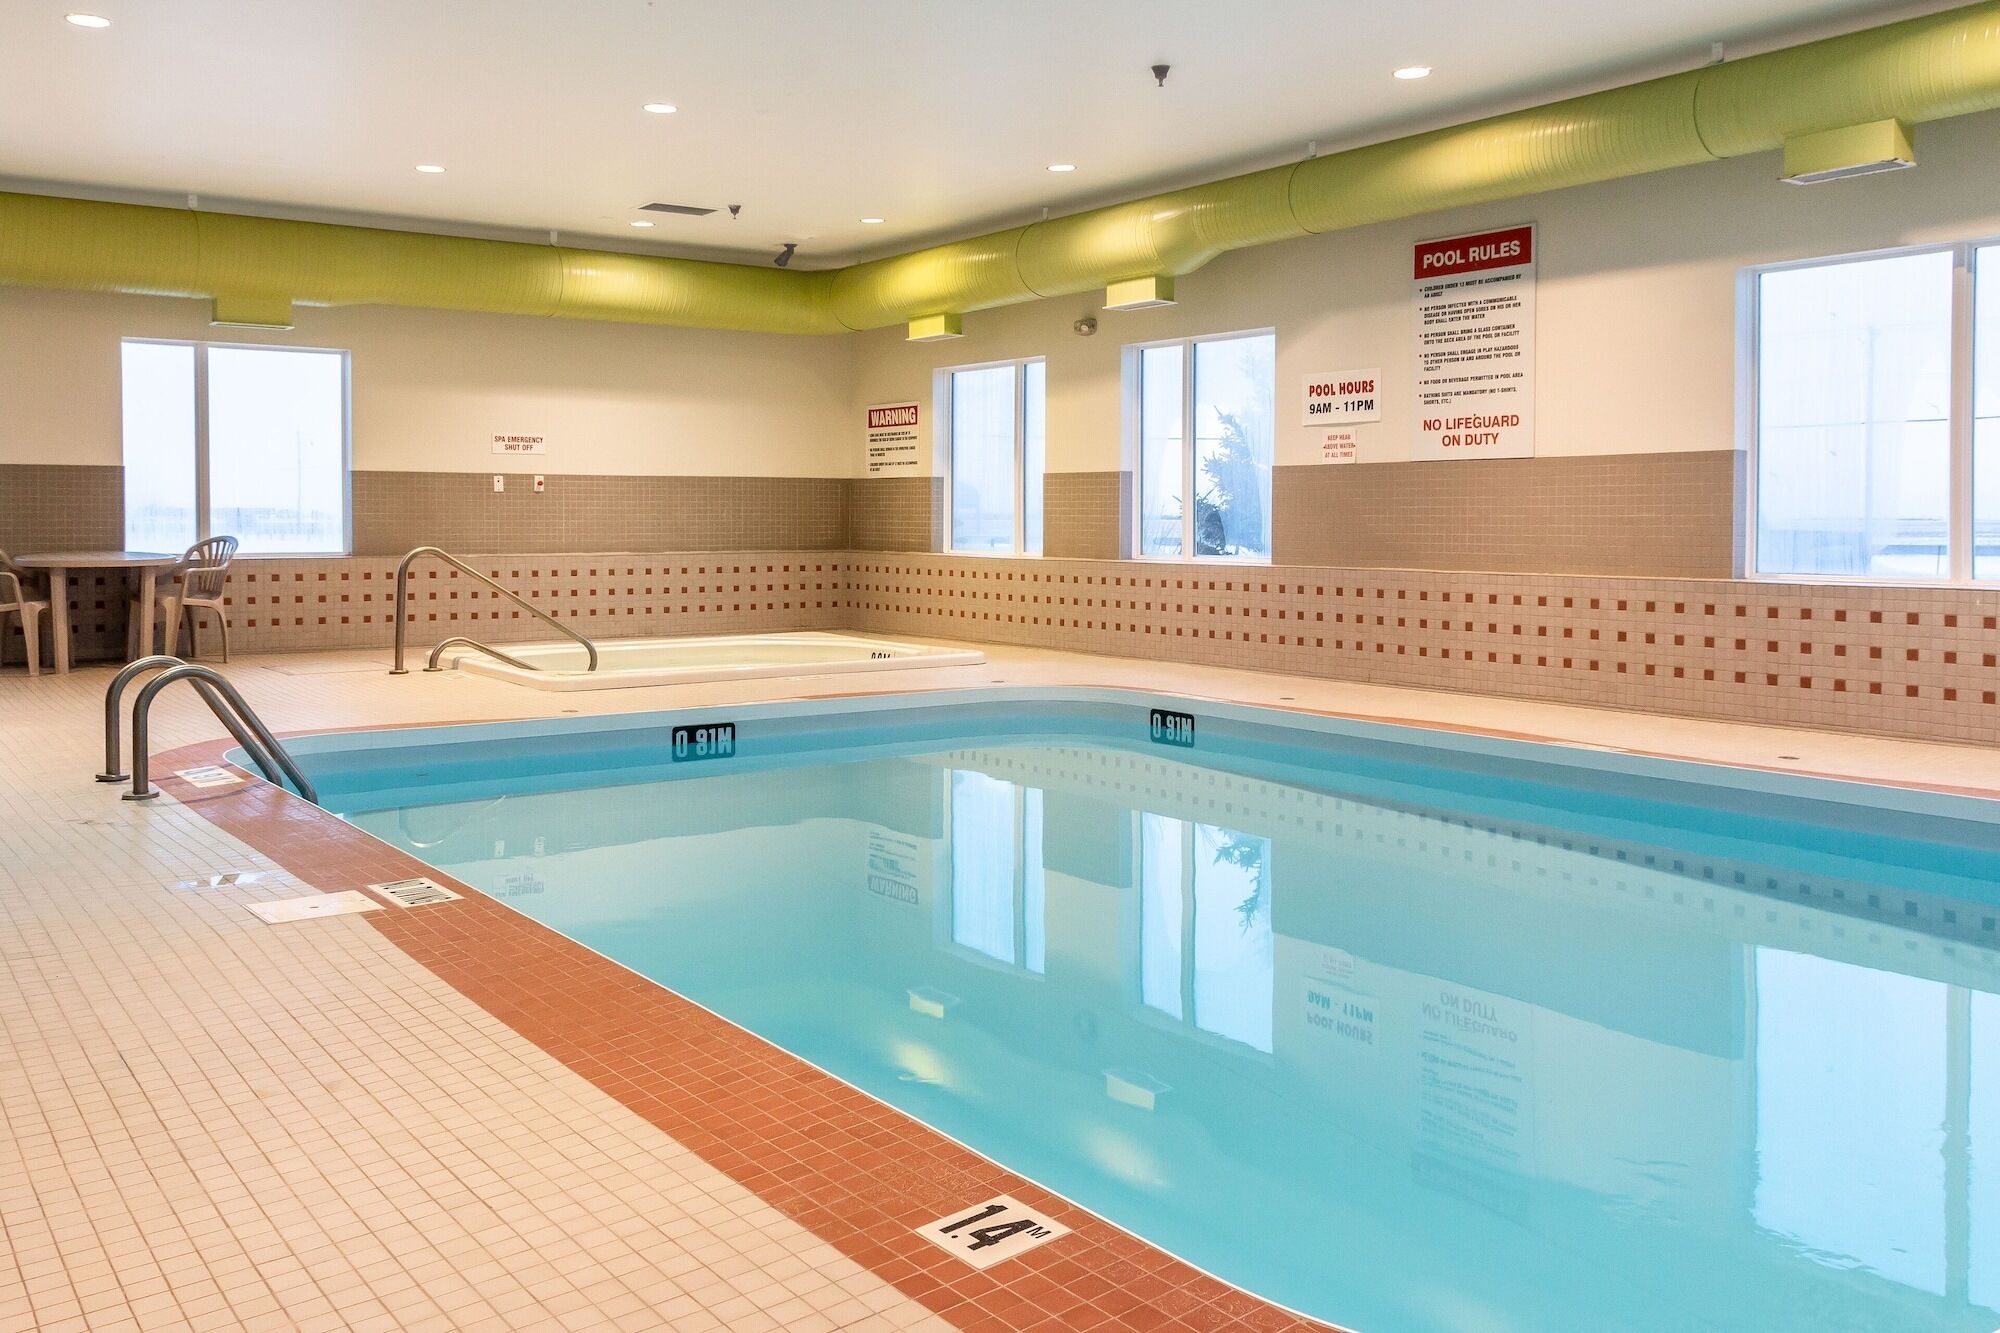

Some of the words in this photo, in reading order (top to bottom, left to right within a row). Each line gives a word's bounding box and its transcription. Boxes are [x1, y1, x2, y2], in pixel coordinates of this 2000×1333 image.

[1423, 250, 1465, 269] POOL
[1469, 241, 1520, 262] RULES
[1309, 384, 1335, 397] POOL
[1339, 380, 1374, 395] HOURS
[1310, 403, 1331, 414] 9AM
[1344, 400, 1373, 412] 11PM
[871, 408, 916, 426] WARNING
[1423, 419, 1441, 431] NO
[1446, 415, 1519, 430] LIFEGUARD
[1442, 434, 1460, 446] ON
[1465, 433, 1499, 446] DUTY
